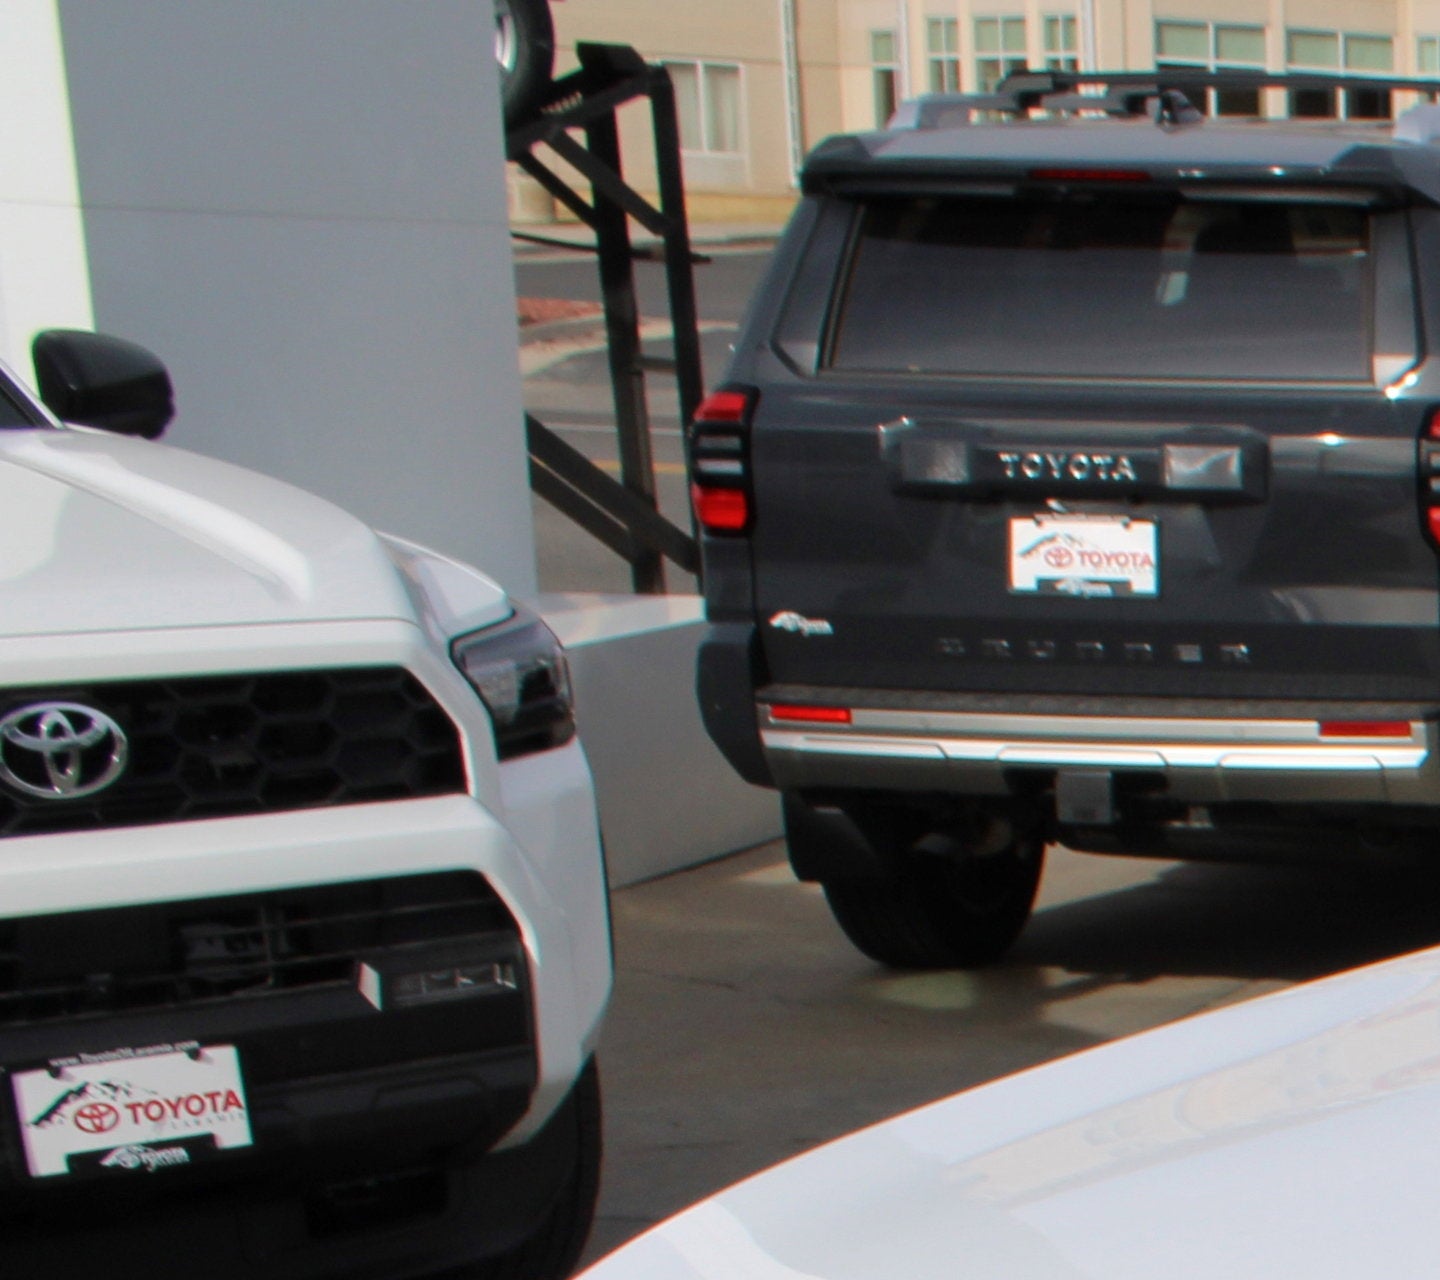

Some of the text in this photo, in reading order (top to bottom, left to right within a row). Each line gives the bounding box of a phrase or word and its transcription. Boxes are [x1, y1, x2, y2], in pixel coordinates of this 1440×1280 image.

[997, 451, 1138, 482] TOYOTA
[1077, 550, 1155, 568] TOYOTA
[123, 1089, 244, 1125] TOYOTA
